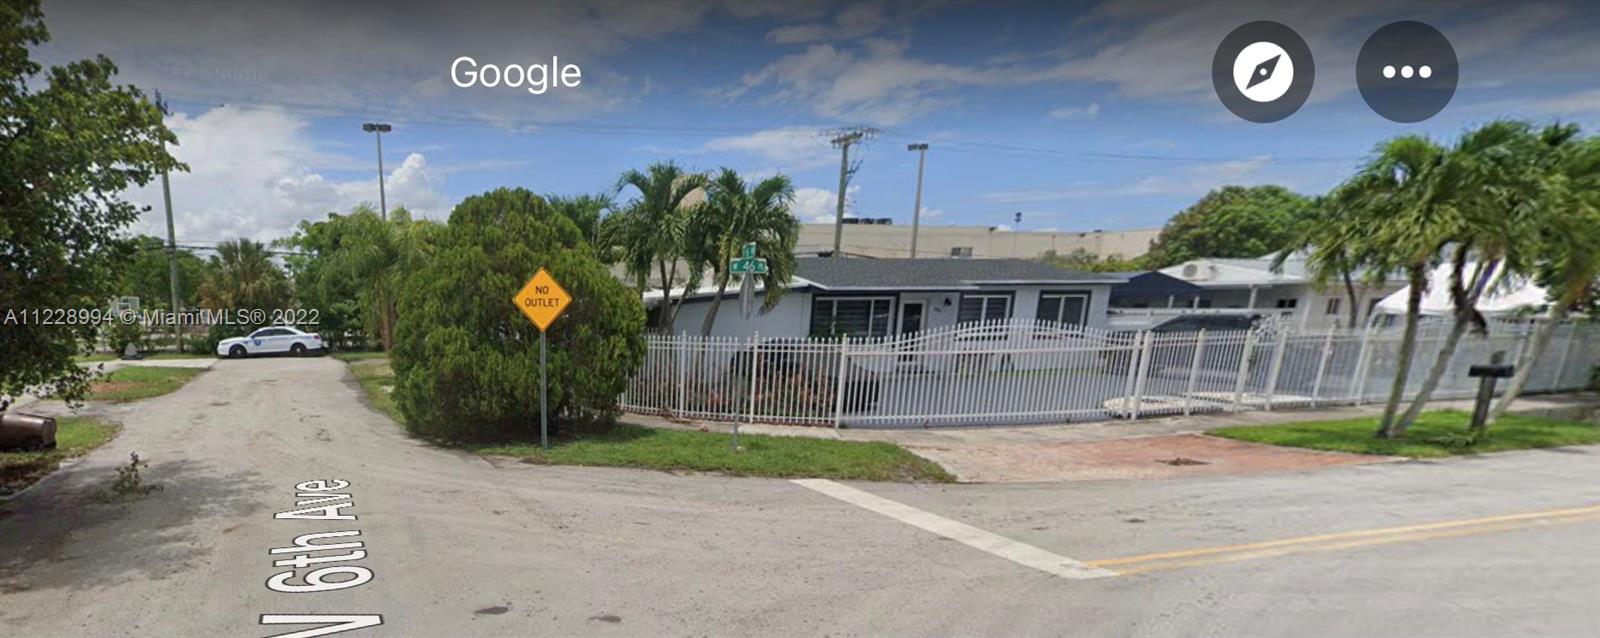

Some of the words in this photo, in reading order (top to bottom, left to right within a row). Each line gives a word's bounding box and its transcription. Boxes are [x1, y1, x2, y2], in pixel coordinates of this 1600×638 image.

[742, 260, 756, 272] 46
[535, 285, 549, 294] NO
[524, 297, 560, 307] OUTLET
